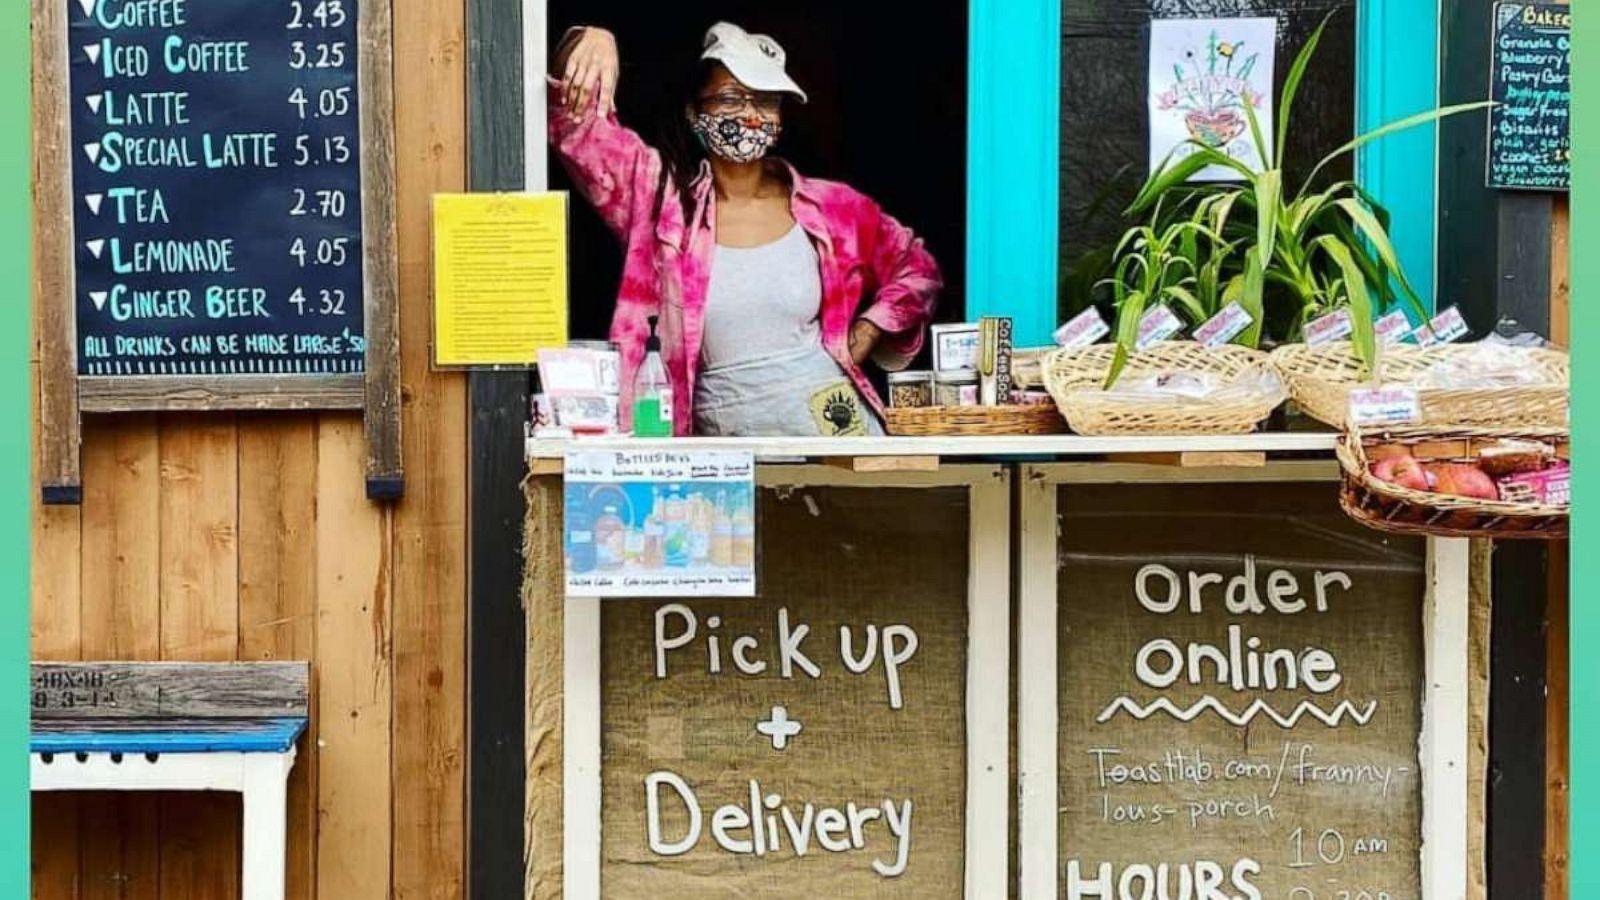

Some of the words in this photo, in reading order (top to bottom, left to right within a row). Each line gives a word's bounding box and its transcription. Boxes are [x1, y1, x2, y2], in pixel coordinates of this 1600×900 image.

[95, 0, 187, 29] COFFEE
[285, 1, 346, 29] 2.43
[102, 37, 149, 78] ICED
[164, 35, 250, 75] COFFEE
[288, 42, 345, 69] 3.25
[105, 90, 190, 127] LATTE
[287, 87, 351, 119] 4.05
[99, 131, 197, 173] SPECIAL
[203, 133, 278, 168] LATTE
[294, 135, 350, 165] 5.13
[108, 187, 170, 224] TEA
[290, 188, 346, 218] 2.70
[110, 237, 236, 274] LEMONADE
[289, 236, 348, 267] 4.05
[110, 283, 195, 321] GINGER
[206, 285, 271, 319] BEER
[289, 287, 346, 317] 4.32
[84, 335, 111, 357] ALL
[115, 335, 176, 356] DRINKS
[181, 336, 211, 355] CAN
[217, 335, 239, 354] BE
[245, 334, 289, 355] MADE
[293, 334, 342, 355] LARGE
[654, 602, 822, 679] Pick
[840, 623, 919, 709] up
[645, 770, 913, 877] Delivery
[1286, 826, 1345, 868] 10
[1353, 838, 1390, 855] AM
[1066, 857, 1263, 900] HOURS
